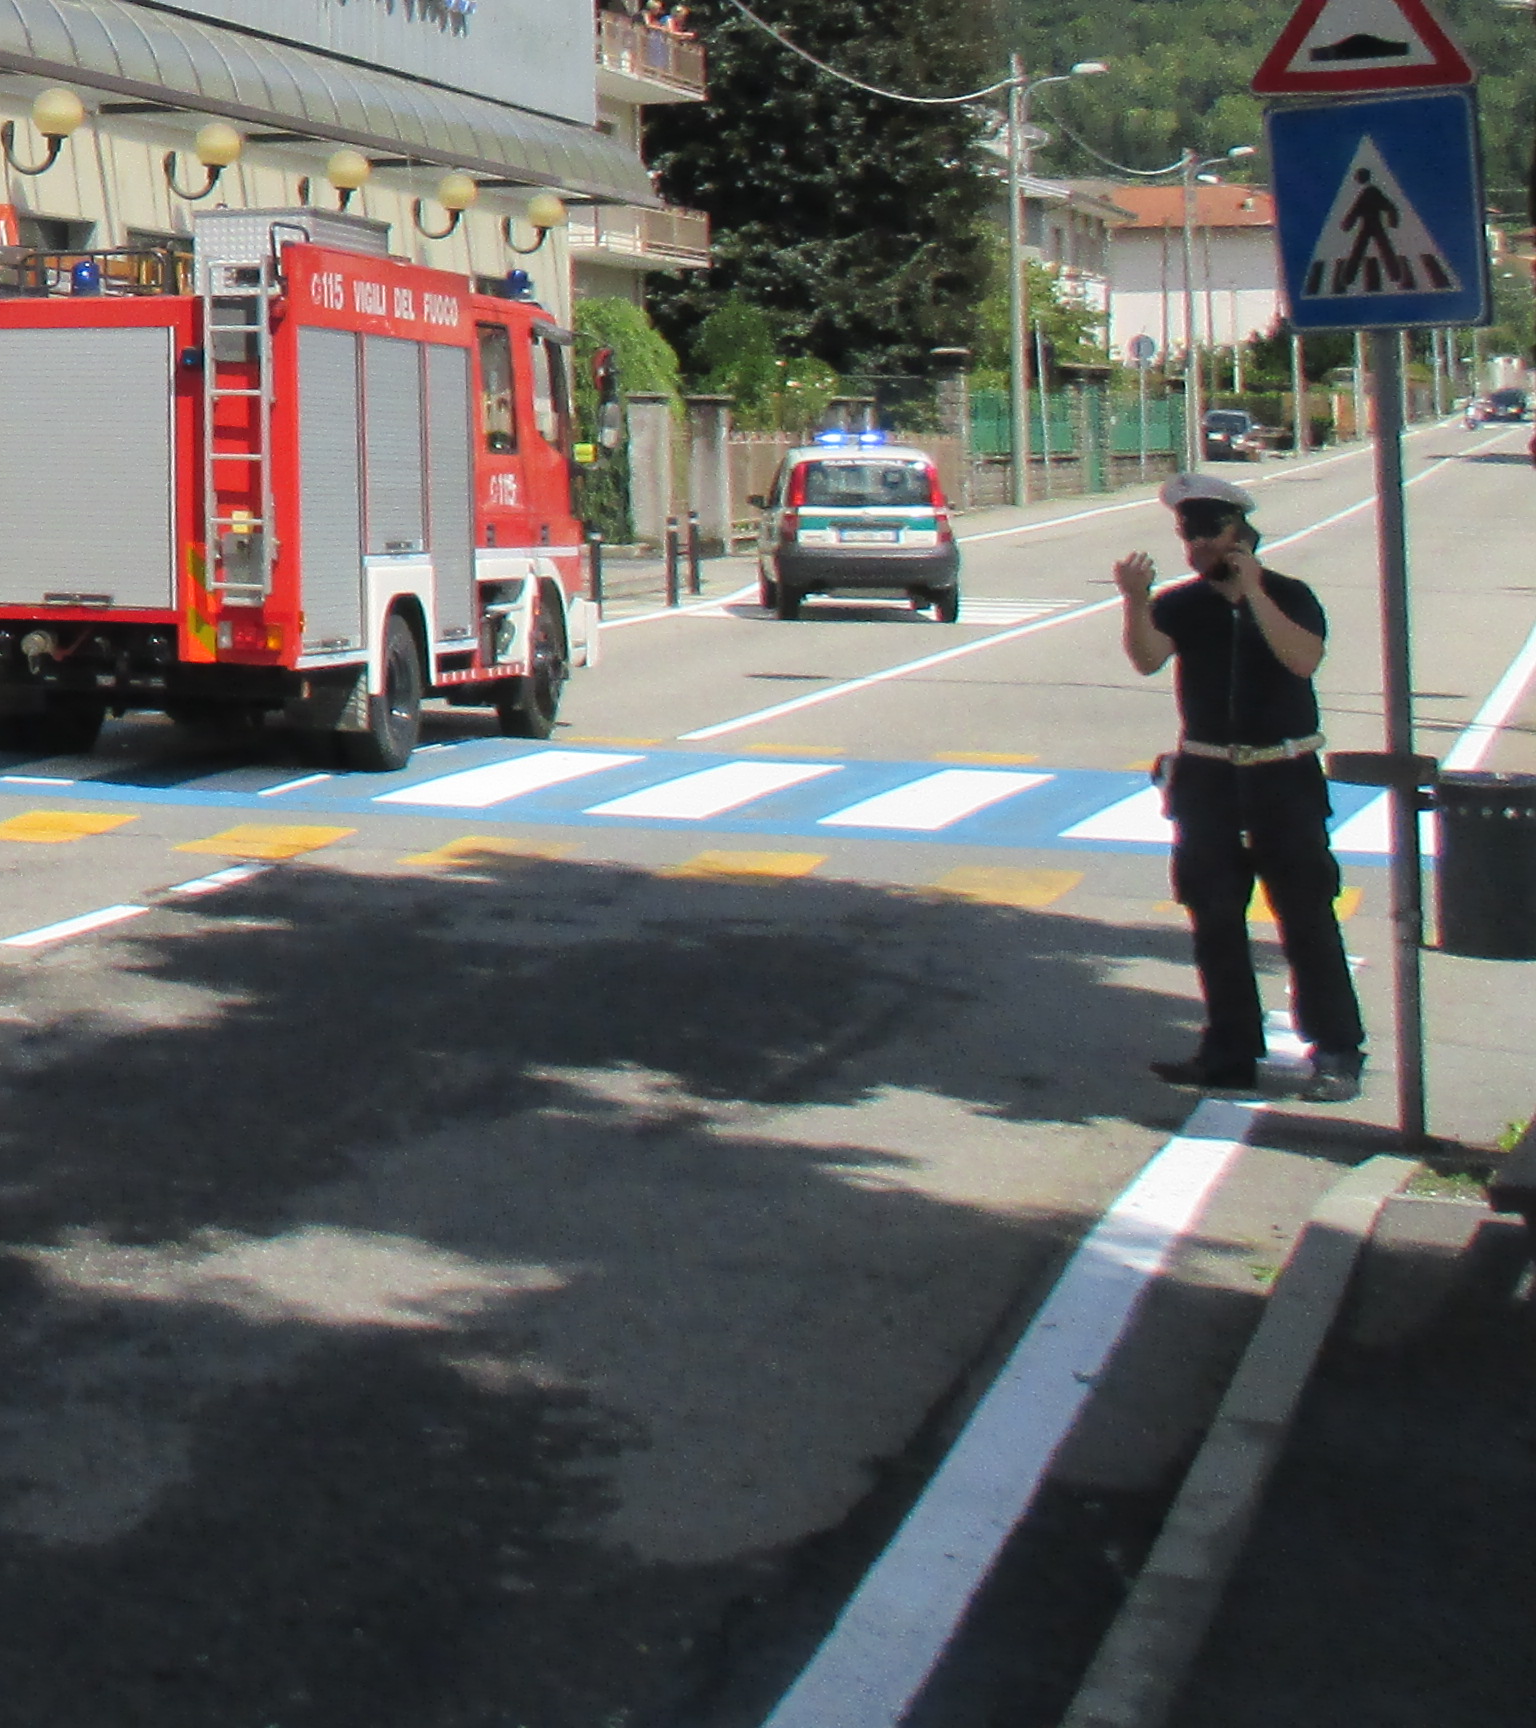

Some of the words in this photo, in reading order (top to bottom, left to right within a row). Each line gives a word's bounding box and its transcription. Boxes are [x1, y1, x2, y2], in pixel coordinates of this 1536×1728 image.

[322, 272, 344, 310] 115
[353, 280, 387, 316] VIGILI
[393, 287, 415, 321] DEL
[423, 292, 458, 327] FUOCO
